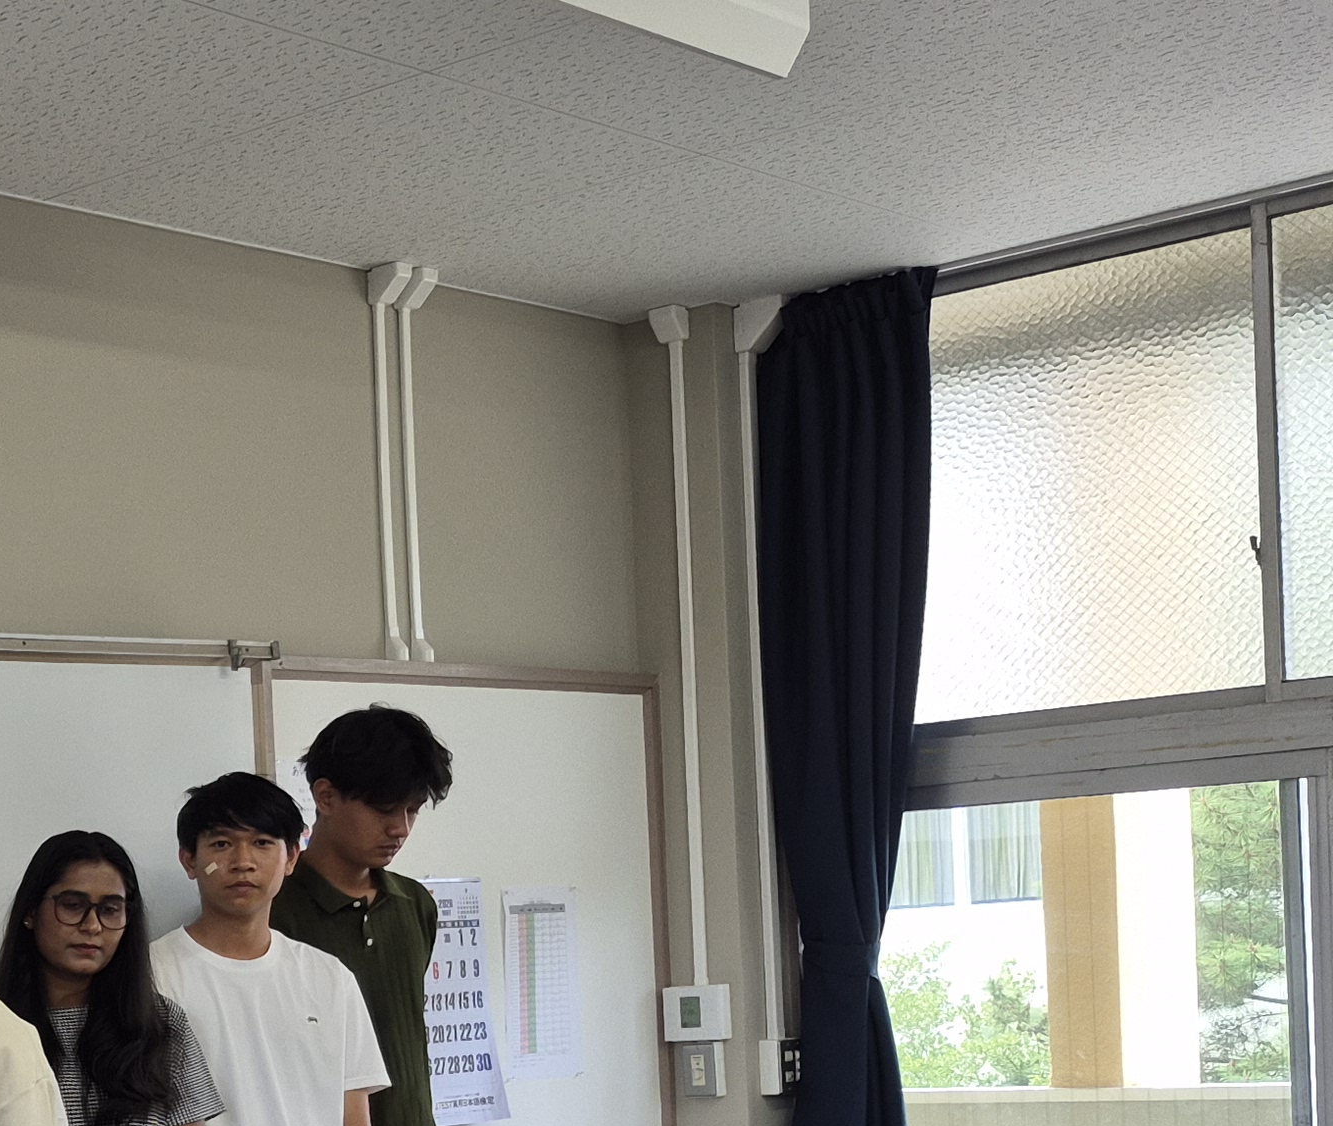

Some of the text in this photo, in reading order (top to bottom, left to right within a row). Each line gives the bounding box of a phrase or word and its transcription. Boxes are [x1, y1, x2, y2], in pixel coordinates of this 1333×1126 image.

[458, 928, 464, 946] 1
[470, 928, 478, 946] 2
[433, 958, 479, 980] 6 7 8 9
[431, 993, 442, 1012] 13
[444, 992, 455, 1010] 14
[458, 991, 469, 1009] 15
[472, 990, 483, 1009] 16
[432, 1025, 444, 1043] 20
[446, 1024, 457, 1042] 21
[460, 1023, 472, 1041] 22
[474, 1022, 487, 1040] 23
[434, 1057, 446, 1075] 27
[448, 1055, 460, 1074] 28
[461, 1054, 474, 1073] 29
[476, 1053, 492, 1072] 30
